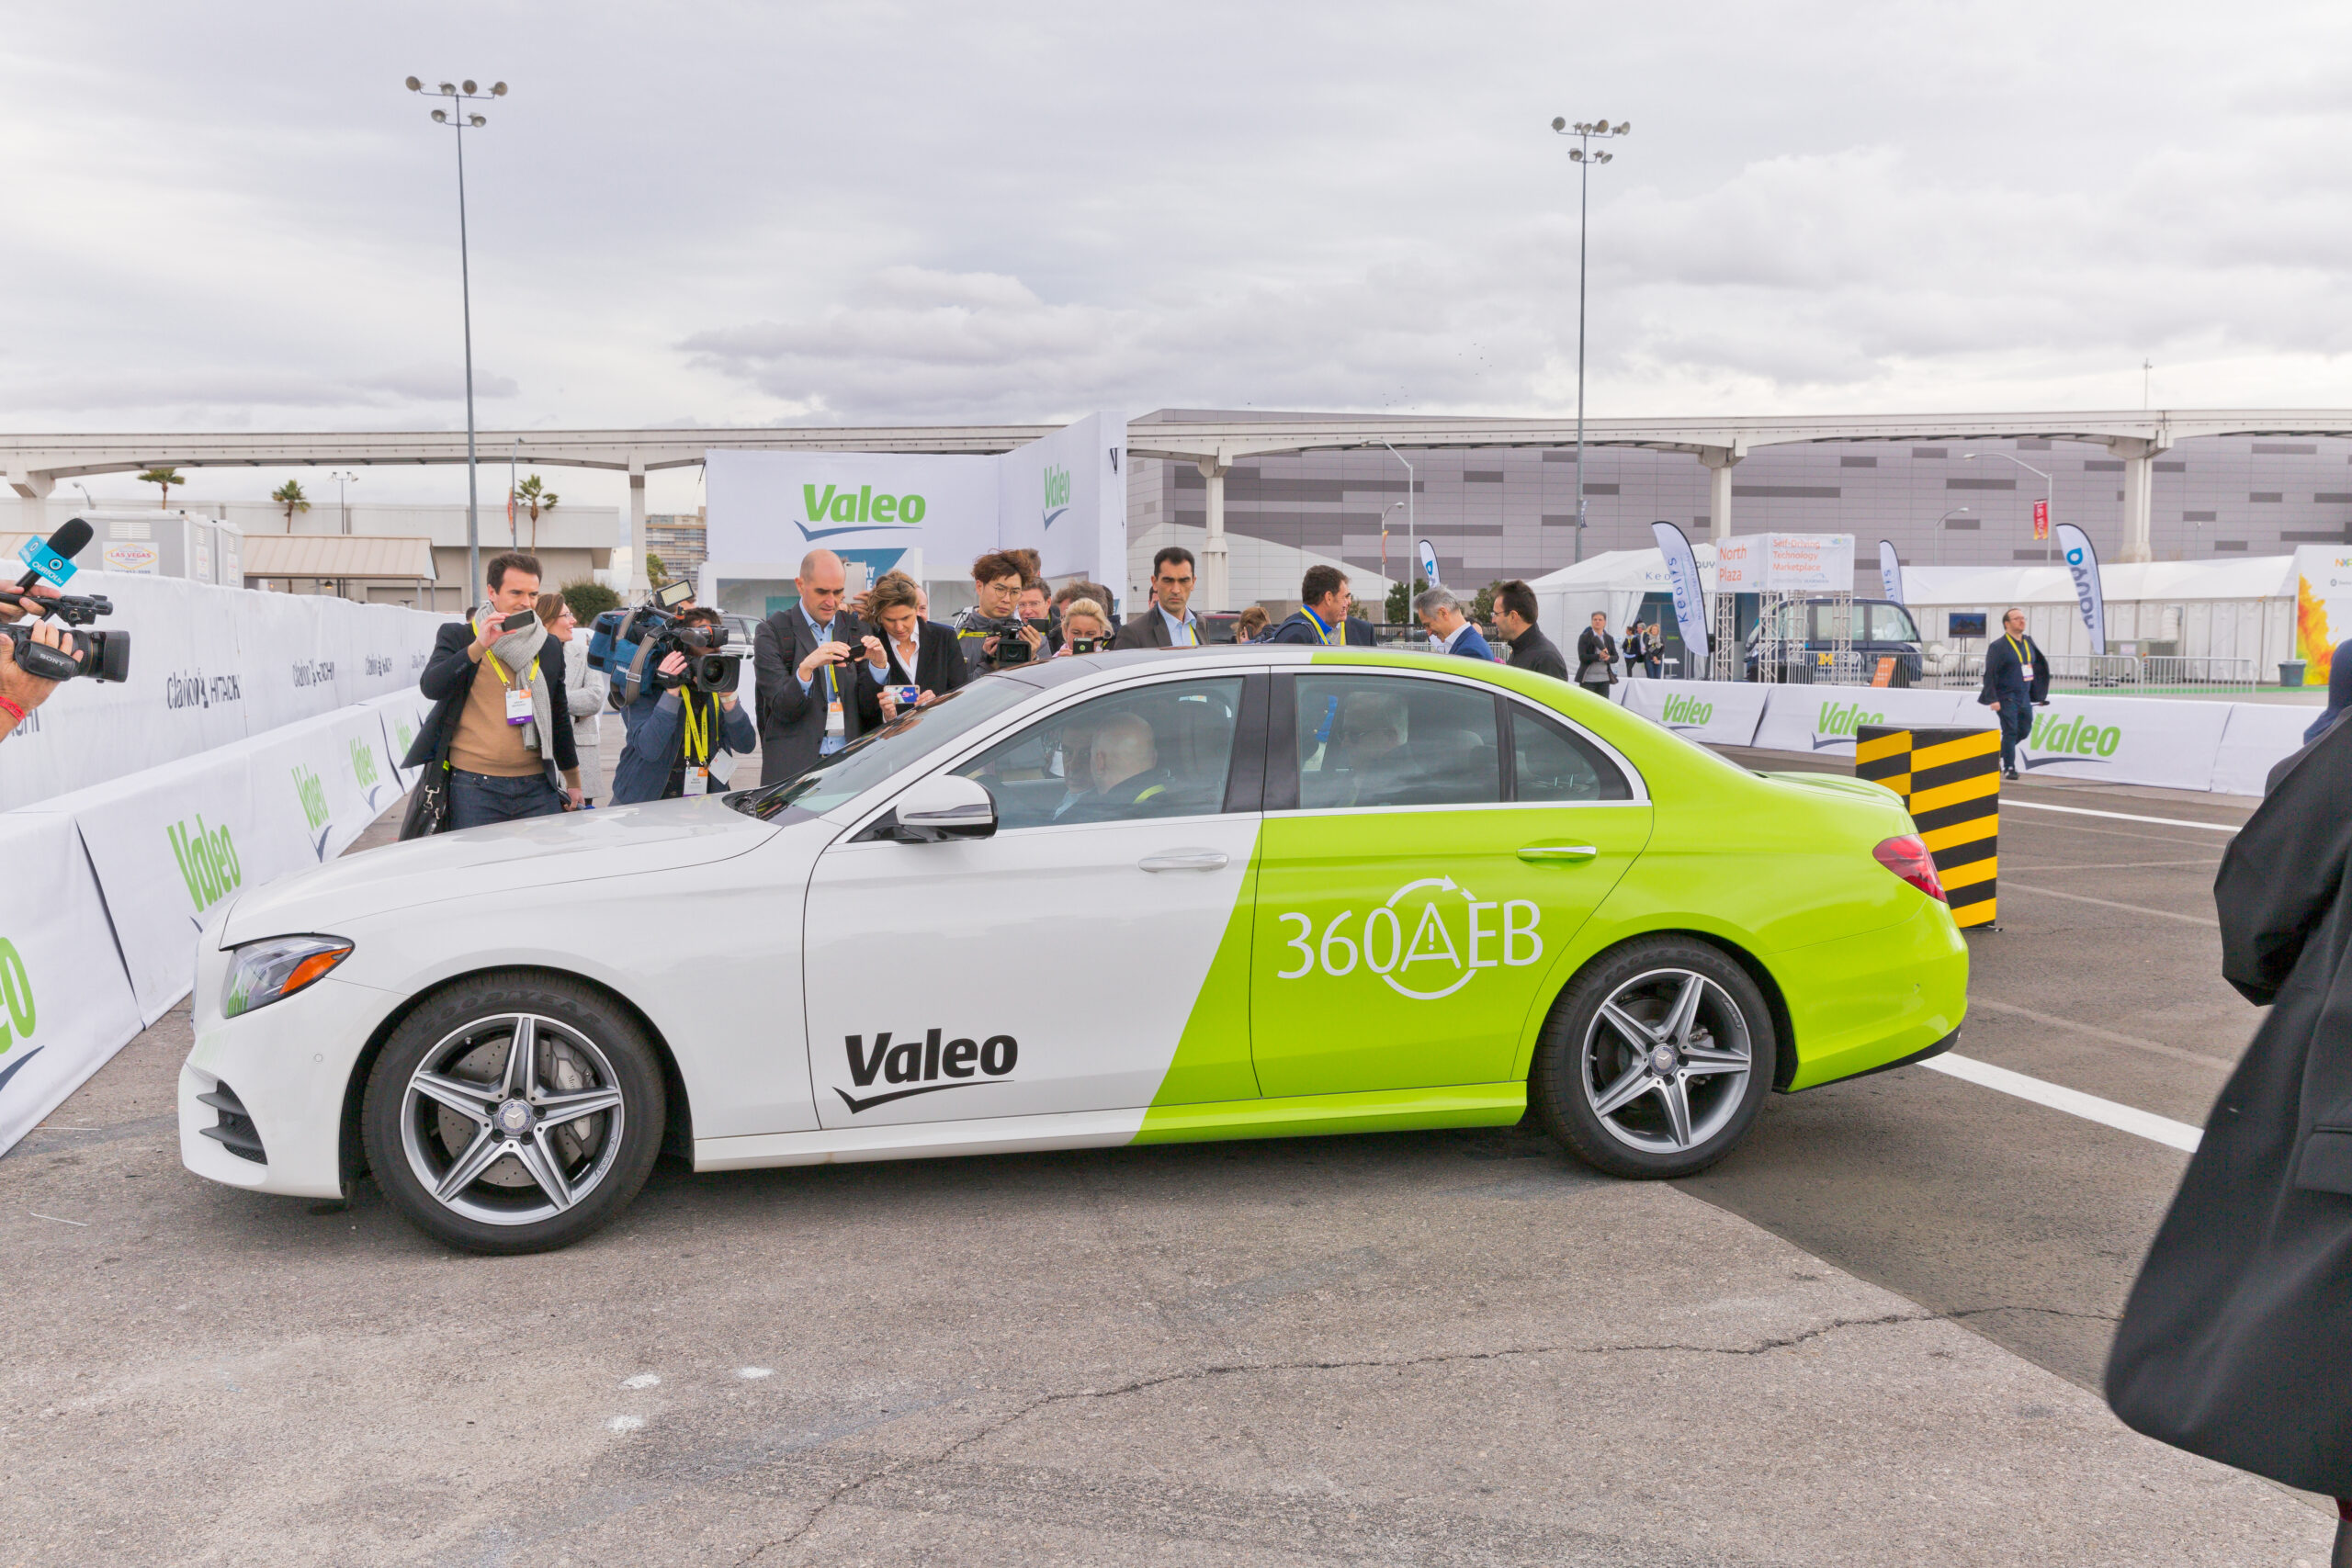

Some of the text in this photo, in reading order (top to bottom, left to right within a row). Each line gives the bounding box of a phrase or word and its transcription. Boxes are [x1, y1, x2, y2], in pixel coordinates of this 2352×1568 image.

[803, 483, 926, 524] Valeo
[1044, 463, 1070, 509] Valeo
[1719, 544, 1747, 561] North
[1772, 538, 1821, 550] Self-Driving
[1772, 550, 1818, 561] Technology
[1719, 566, 1743, 582] Plaza
[1772, 562, 1821, 573] Marketplace
[40, 653, 65, 667] SONY
[1662, 694, 1713, 726] Valeo
[2030, 713, 2121, 757] Valeo
[349, 735, 379, 789] Valeo
[290, 762, 330, 831] Valeo
[166, 813, 242, 913] Valeo
[844, 1028, 1018, 1088] Valeo
